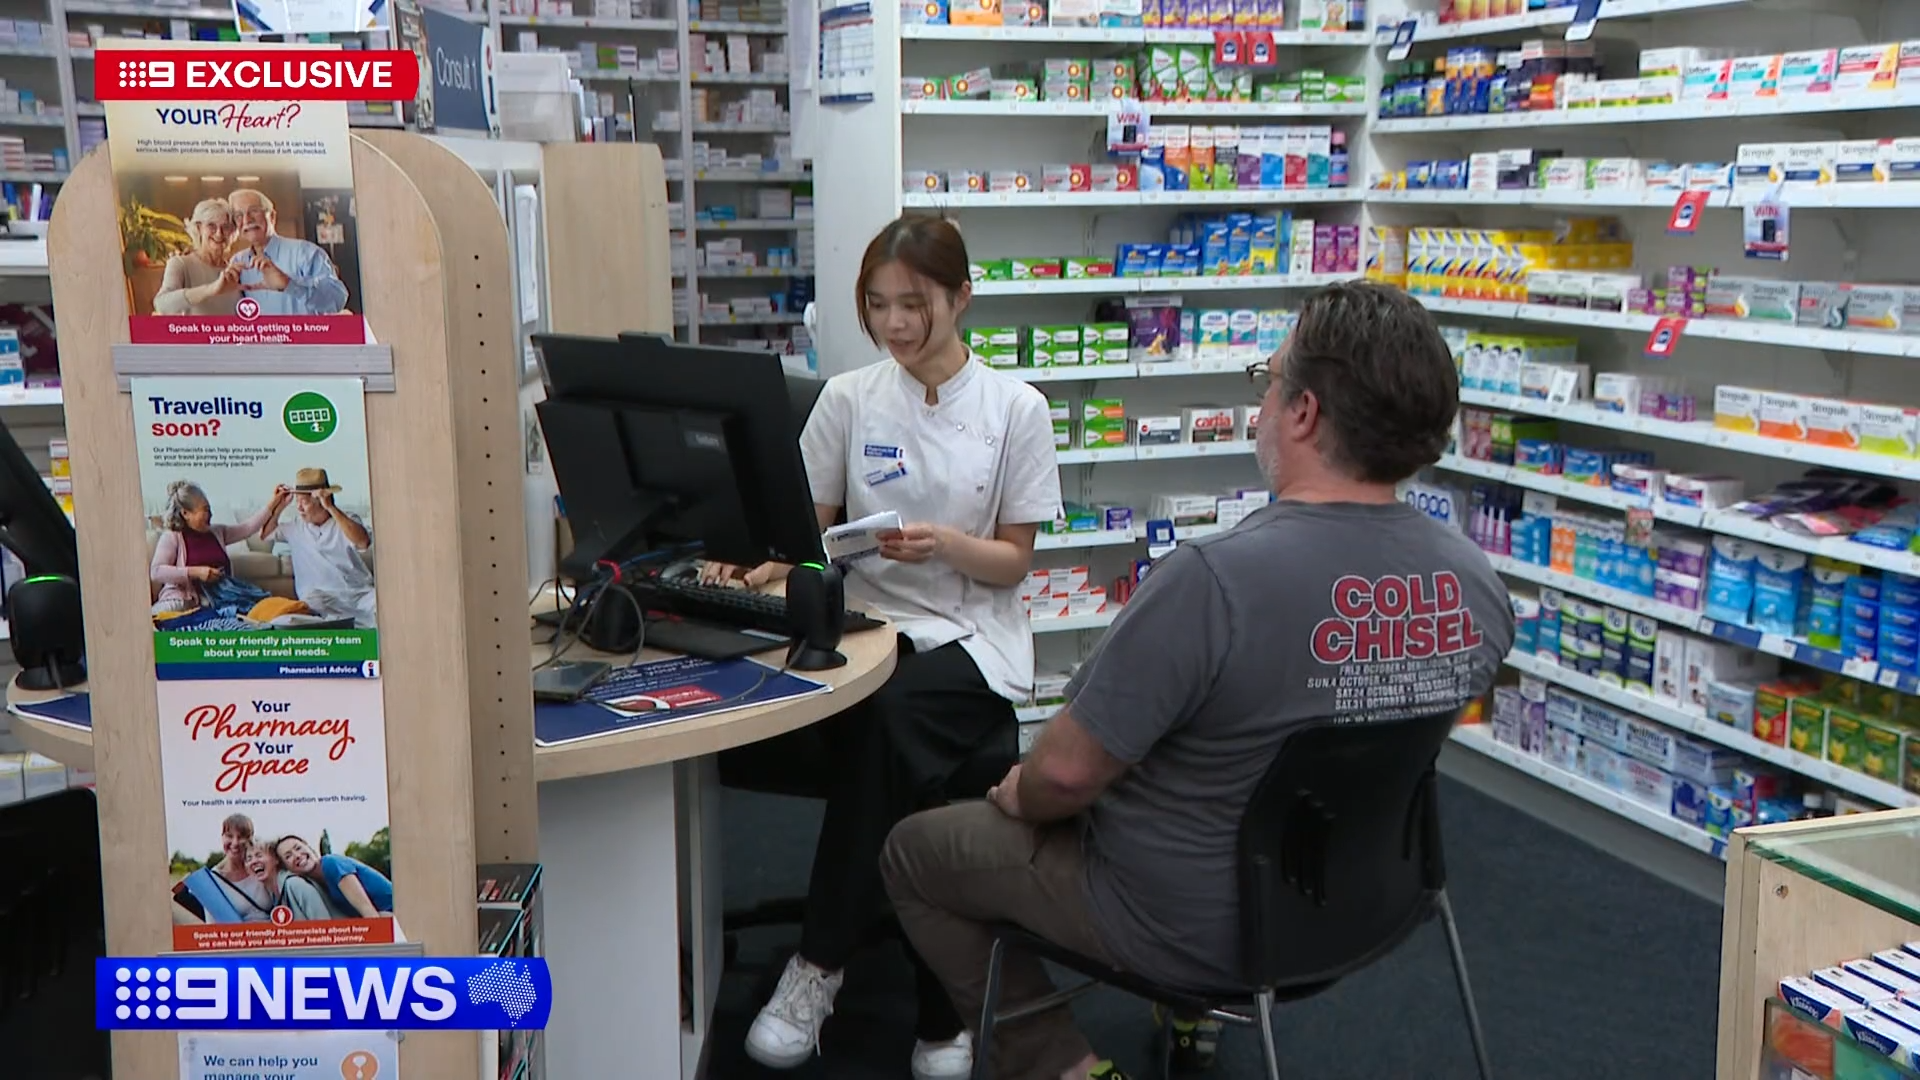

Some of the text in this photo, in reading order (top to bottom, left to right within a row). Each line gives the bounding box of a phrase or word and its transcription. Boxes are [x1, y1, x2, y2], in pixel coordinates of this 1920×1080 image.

[436, 46, 472, 92] Consult
[156, 103, 301, 133] YOUR Heart?
[1116, 112, 1141, 124] WIN
[137, 139, 152, 147] High
[240, 140, 274, 148] symptoms,
[168, 323, 329, 334] Speak to us about getting to know
[209, 333, 292, 344] your heart health.
[148, 396, 264, 418] Travelling
[151, 419, 221, 437] soon?
[1195, 412, 1232, 429] cartia
[1331, 570, 1462, 621] COLD
[169, 636, 362, 648] Speak to our friendly pharmacy team
[1310, 608, 1484, 665] CHISEL
[203, 647, 330, 659] about your travel needs.
[279, 666, 328, 675] Pharmacist
[329, 665, 358, 674] Advice
[1363, 661, 1400, 675] OCTOBER
[1307, 677, 1337, 688] SUN.4
[1339, 674, 1380, 688] OCTOBER
[1389, 672, 1417, 685] SYDNEY
[1335, 687, 1365, 699] SAT.24
[1366, 684, 1404, 698] OCTOBER
[1413, 680, 1433, 693] GOLD
[252, 700, 291, 713] Your
[1335, 699, 1363, 711] SAT.31
[1366, 694, 1407, 709] OCTOBER
[184, 703, 356, 761] Pharmacy
[254, 741, 294, 755] Your
[215, 742, 310, 793] Space
[234, 798, 260, 806] always
[268, 796, 316, 805] conversation
[340, 795, 368, 803] having.
[193, 931, 218, 941] Speak
[246, 929, 276, 938] friendly
[277, 927, 327, 936] Pharmacists
[328, 926, 351, 934] about
[351, 925, 370, 933] how
[229, 940, 247, 948] help
[248, 939, 263, 947] you
[264, 938, 286, 946] along
[306, 936, 332, 944] health
[333, 935, 366, 943] journey.
[203, 1055, 318, 1069] We can help you
